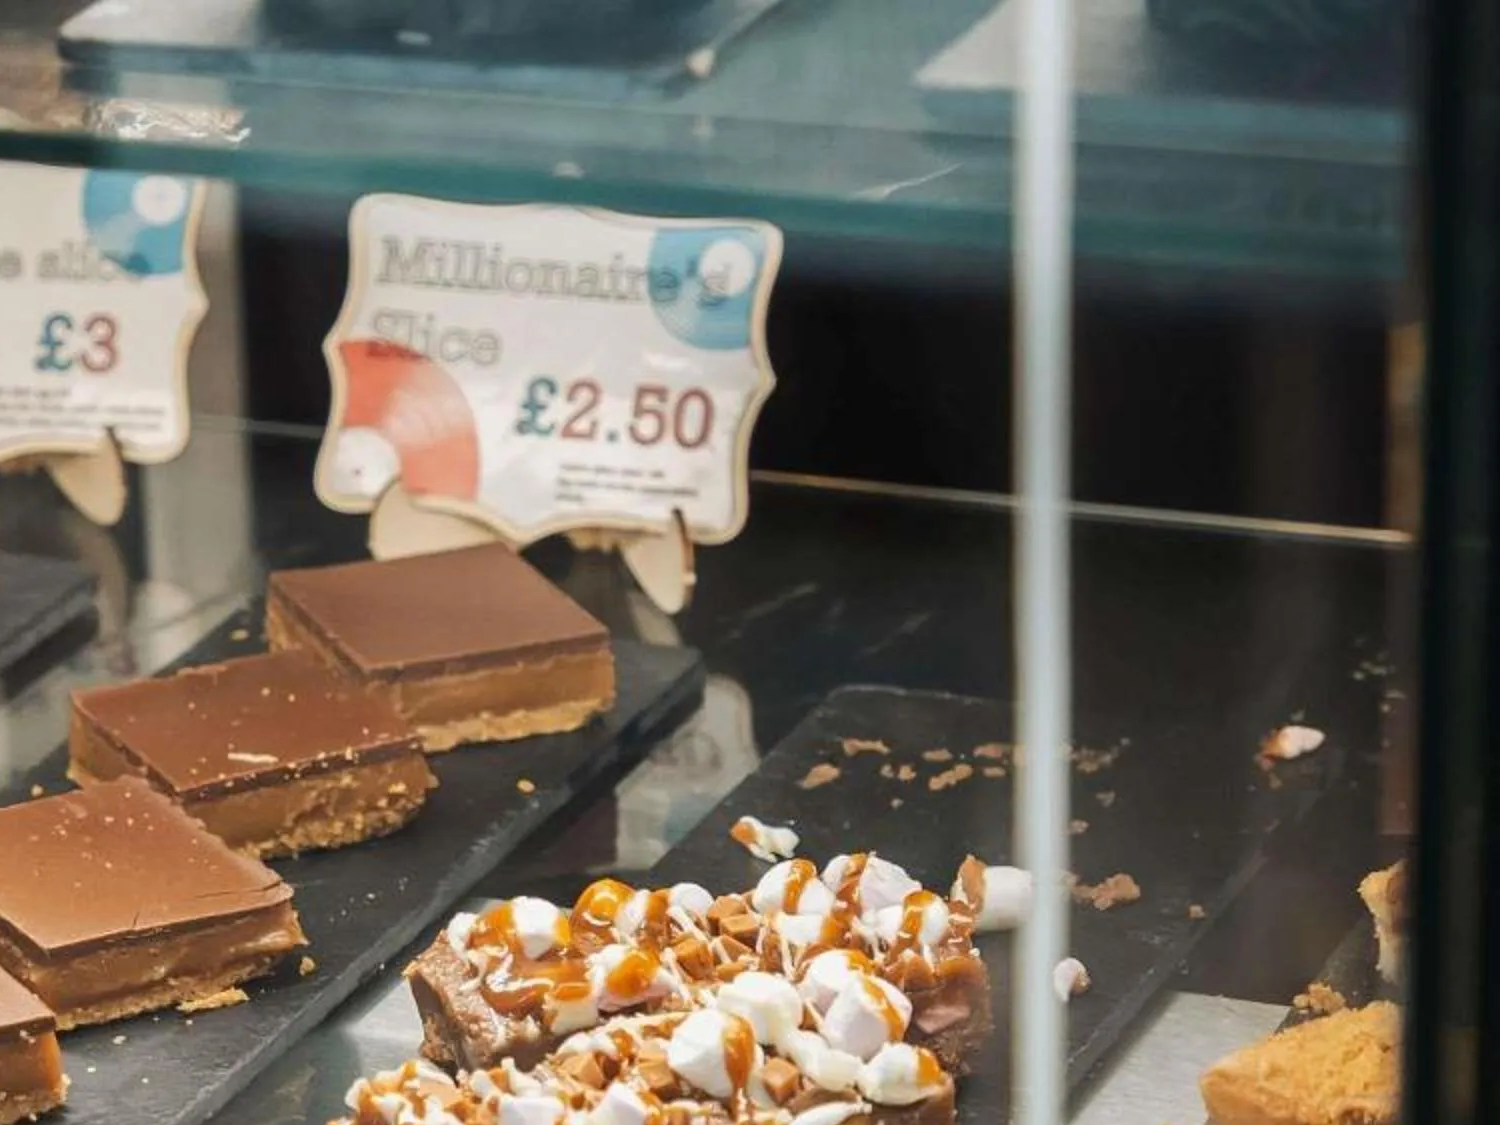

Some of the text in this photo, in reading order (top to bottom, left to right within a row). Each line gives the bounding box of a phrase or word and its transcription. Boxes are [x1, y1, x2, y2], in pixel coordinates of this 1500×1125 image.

[375, 233, 734, 307] Millionaire's
[35, 313, 117, 372] £3
[367, 308, 502, 366] Slice
[514, 376, 715, 450] £2.50
